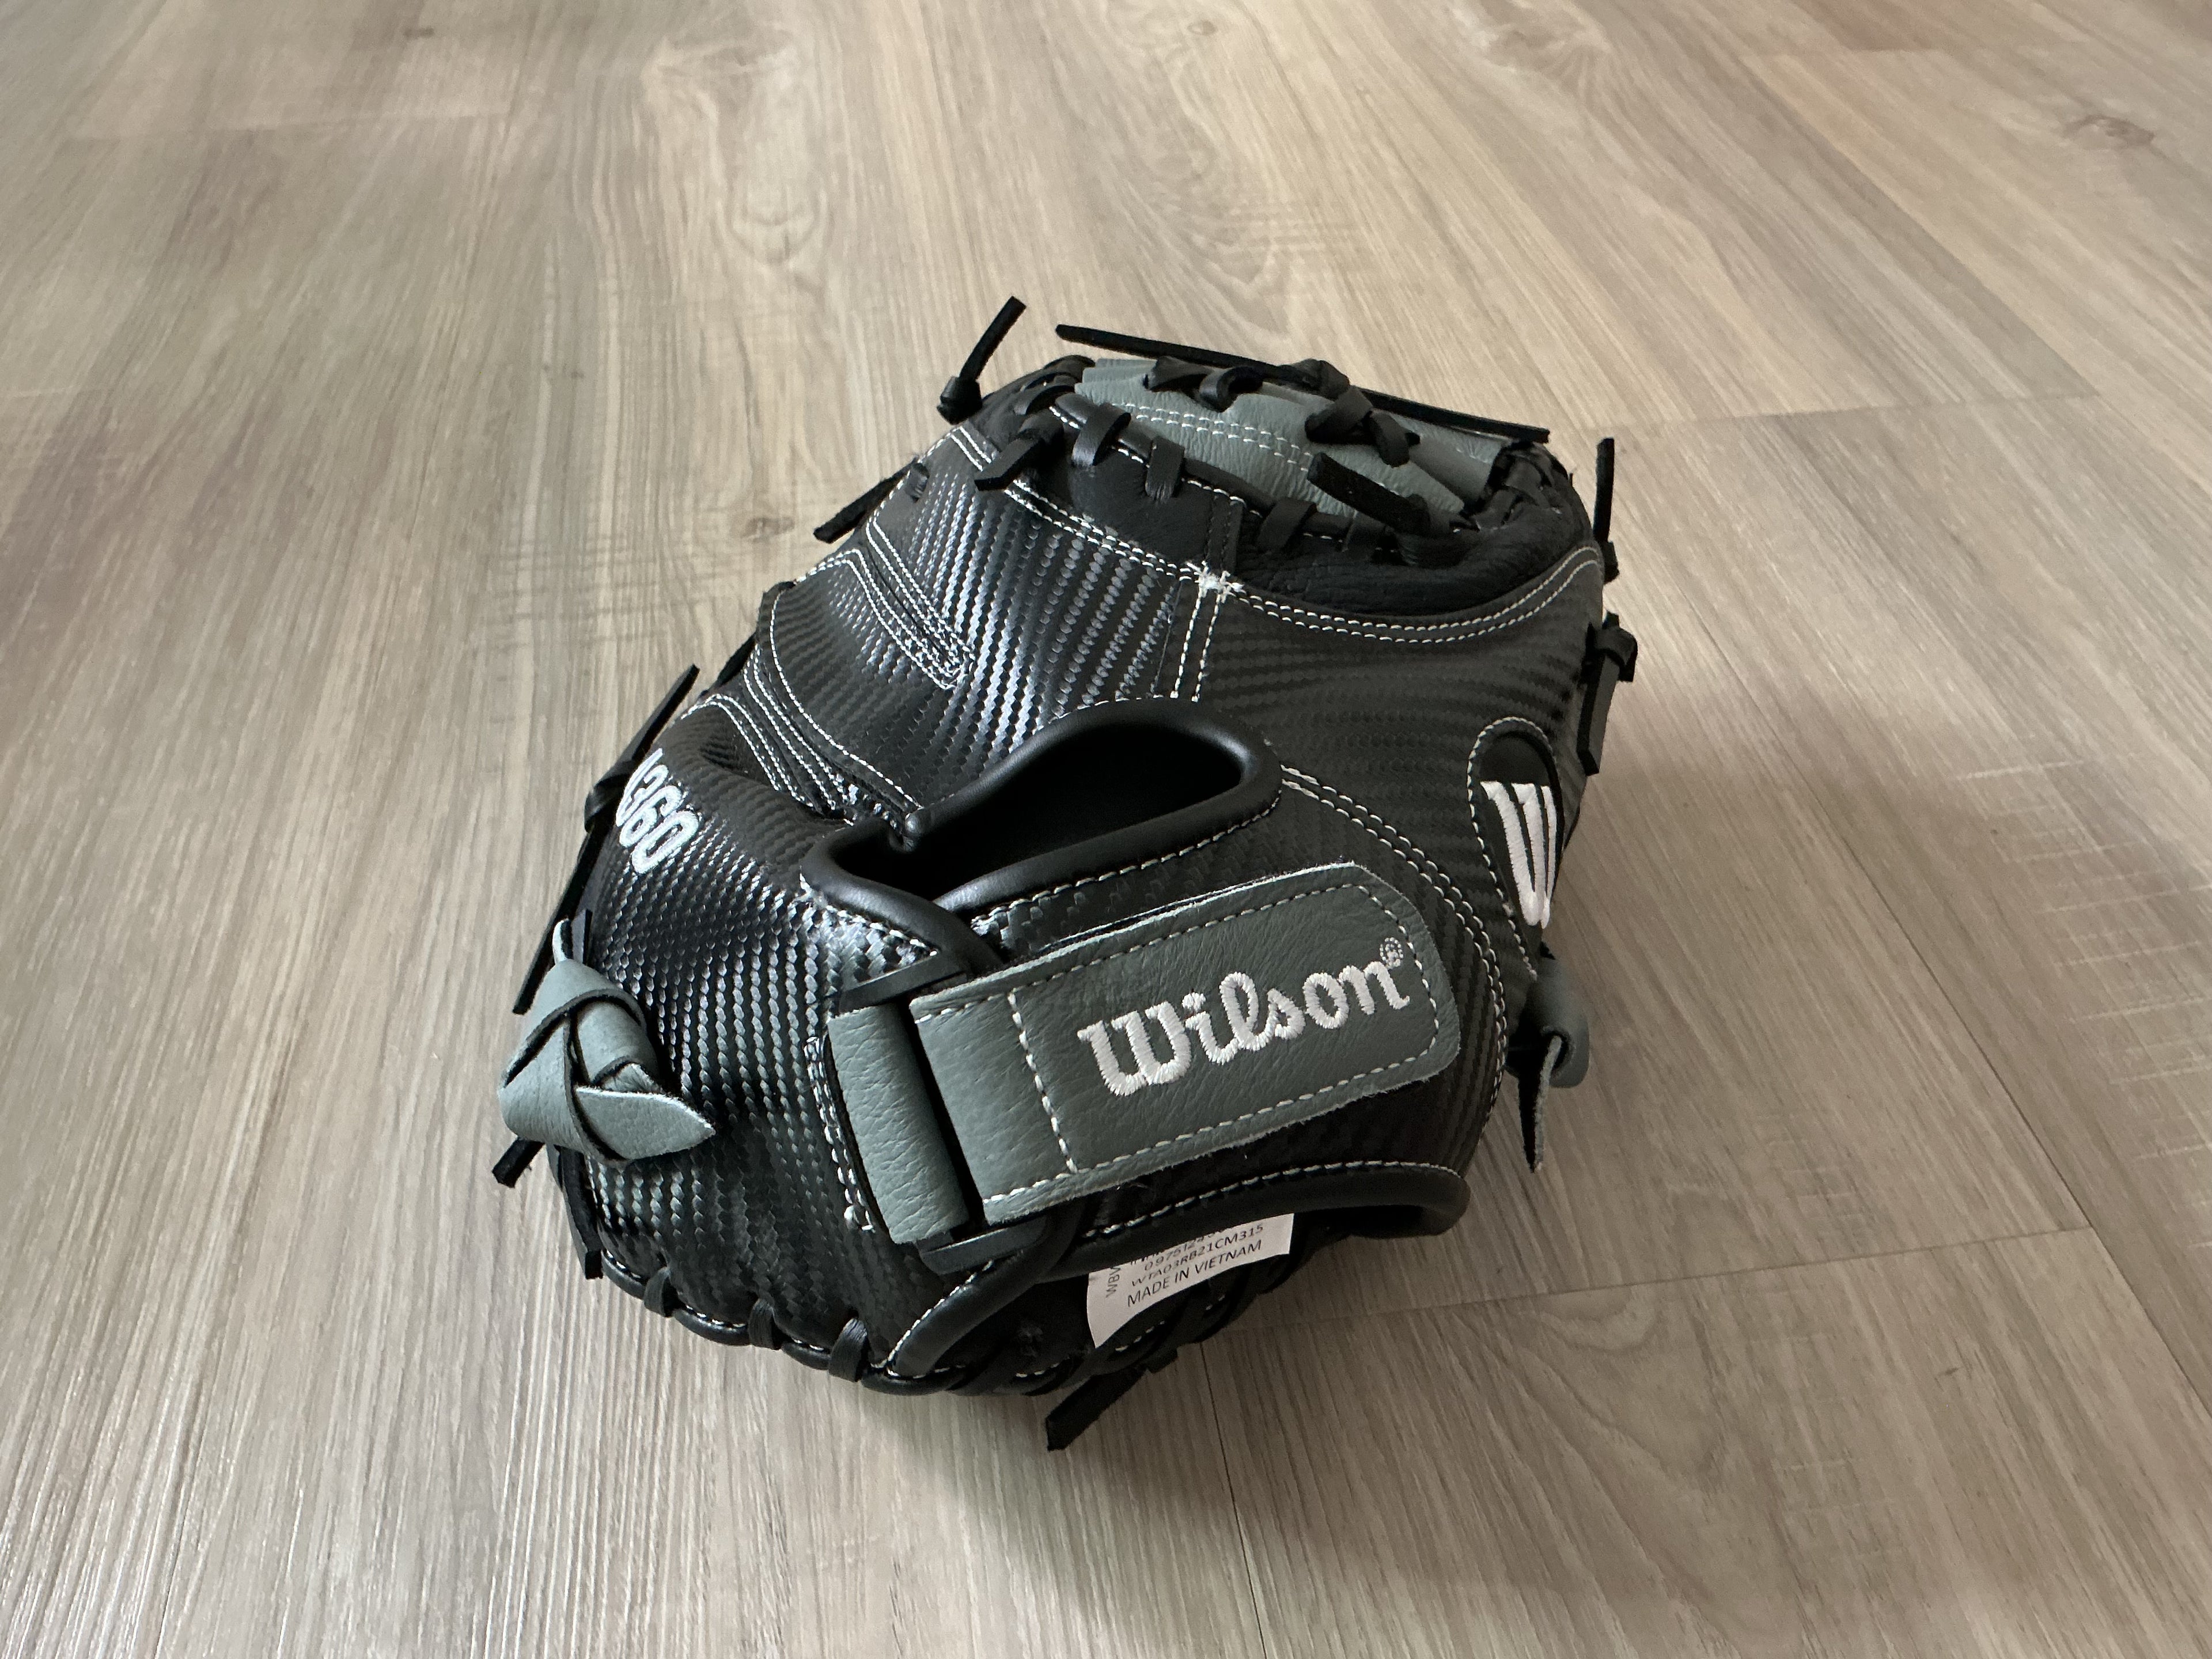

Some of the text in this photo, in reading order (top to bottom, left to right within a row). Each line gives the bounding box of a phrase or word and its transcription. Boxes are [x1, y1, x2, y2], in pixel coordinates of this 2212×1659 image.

[1127, 1239, 1262, 1308] MADE IN VIETNAM
